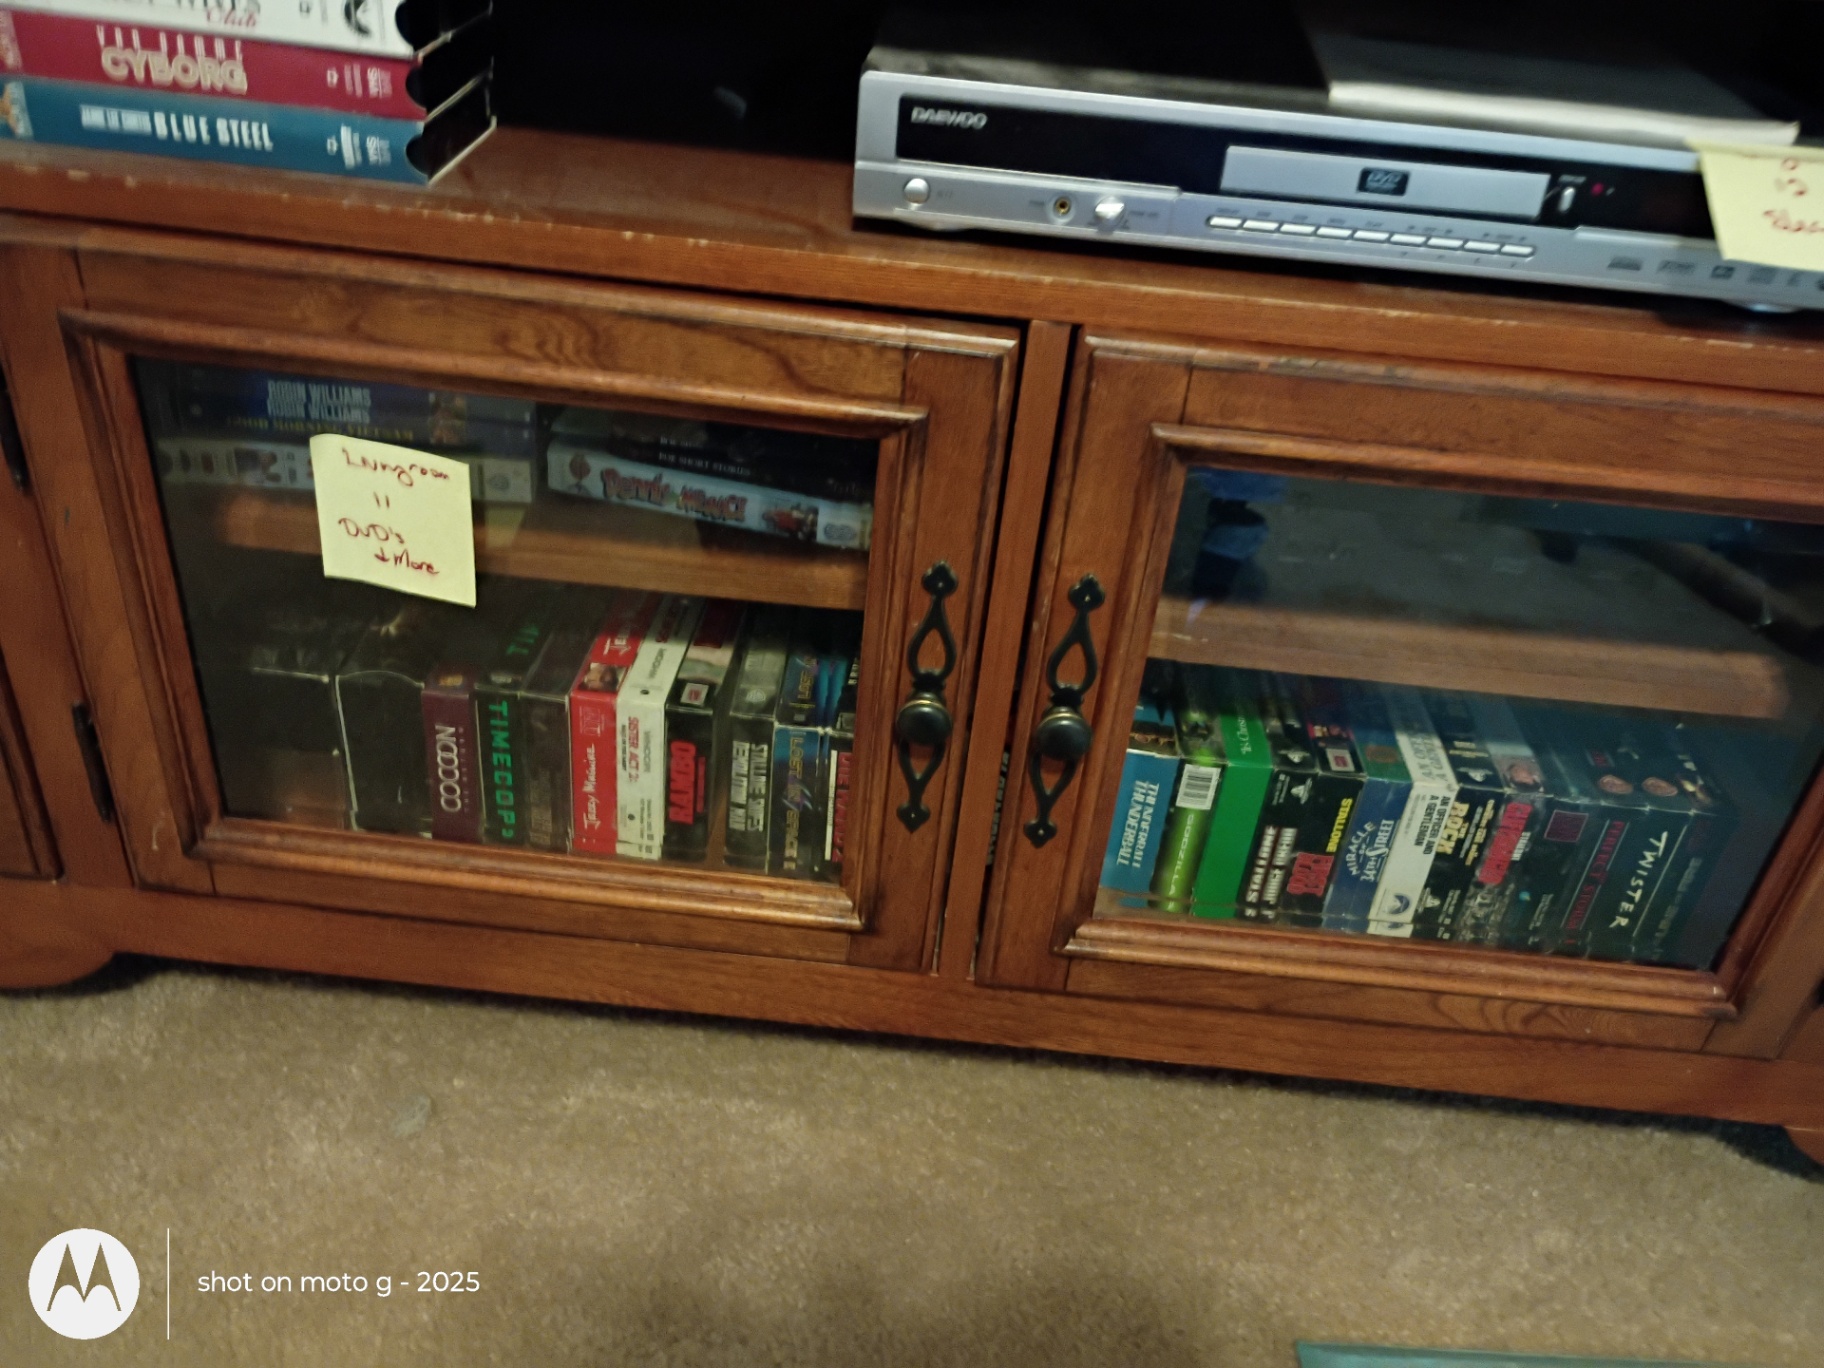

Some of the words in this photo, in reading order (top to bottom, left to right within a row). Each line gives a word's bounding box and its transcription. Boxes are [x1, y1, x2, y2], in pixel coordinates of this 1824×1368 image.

[101, 47, 248, 95] CYBORG
[154, 112, 211, 145] BLUE
[216, 117, 274, 152] STEEL
[910, 106, 987, 130] DAEWOO
[308, 382, 371, 408] WILLIAMS
[628, 716, 639, 749] SISTER
[435, 723, 461, 813] COCOON
[488, 701, 515, 827] TIMECOP
[629, 751, 639, 770] ACT
[788, 737, 804, 779] LOST
[669, 740, 697, 824] RAMBO
[1440, 796, 1450, 806] AN
[783, 809, 800, 858] SPACE
[1116, 780, 1150, 866] THUNDERBALL
[1326, 797, 1353, 852] STALLONE
[1364, 819, 1394, 857] STREET
[1414, 802, 1437, 847] GENTLEMAN
[1429, 808, 1448, 838] OFFICER
[1436, 801, 1469, 854] ROCK
[1168, 814, 1196, 895] GODZILLA
[1345, 821, 1377, 876] MIRACLE
[1423, 840, 1437, 855] AND
[1608, 831, 1668, 928] TWISTER
